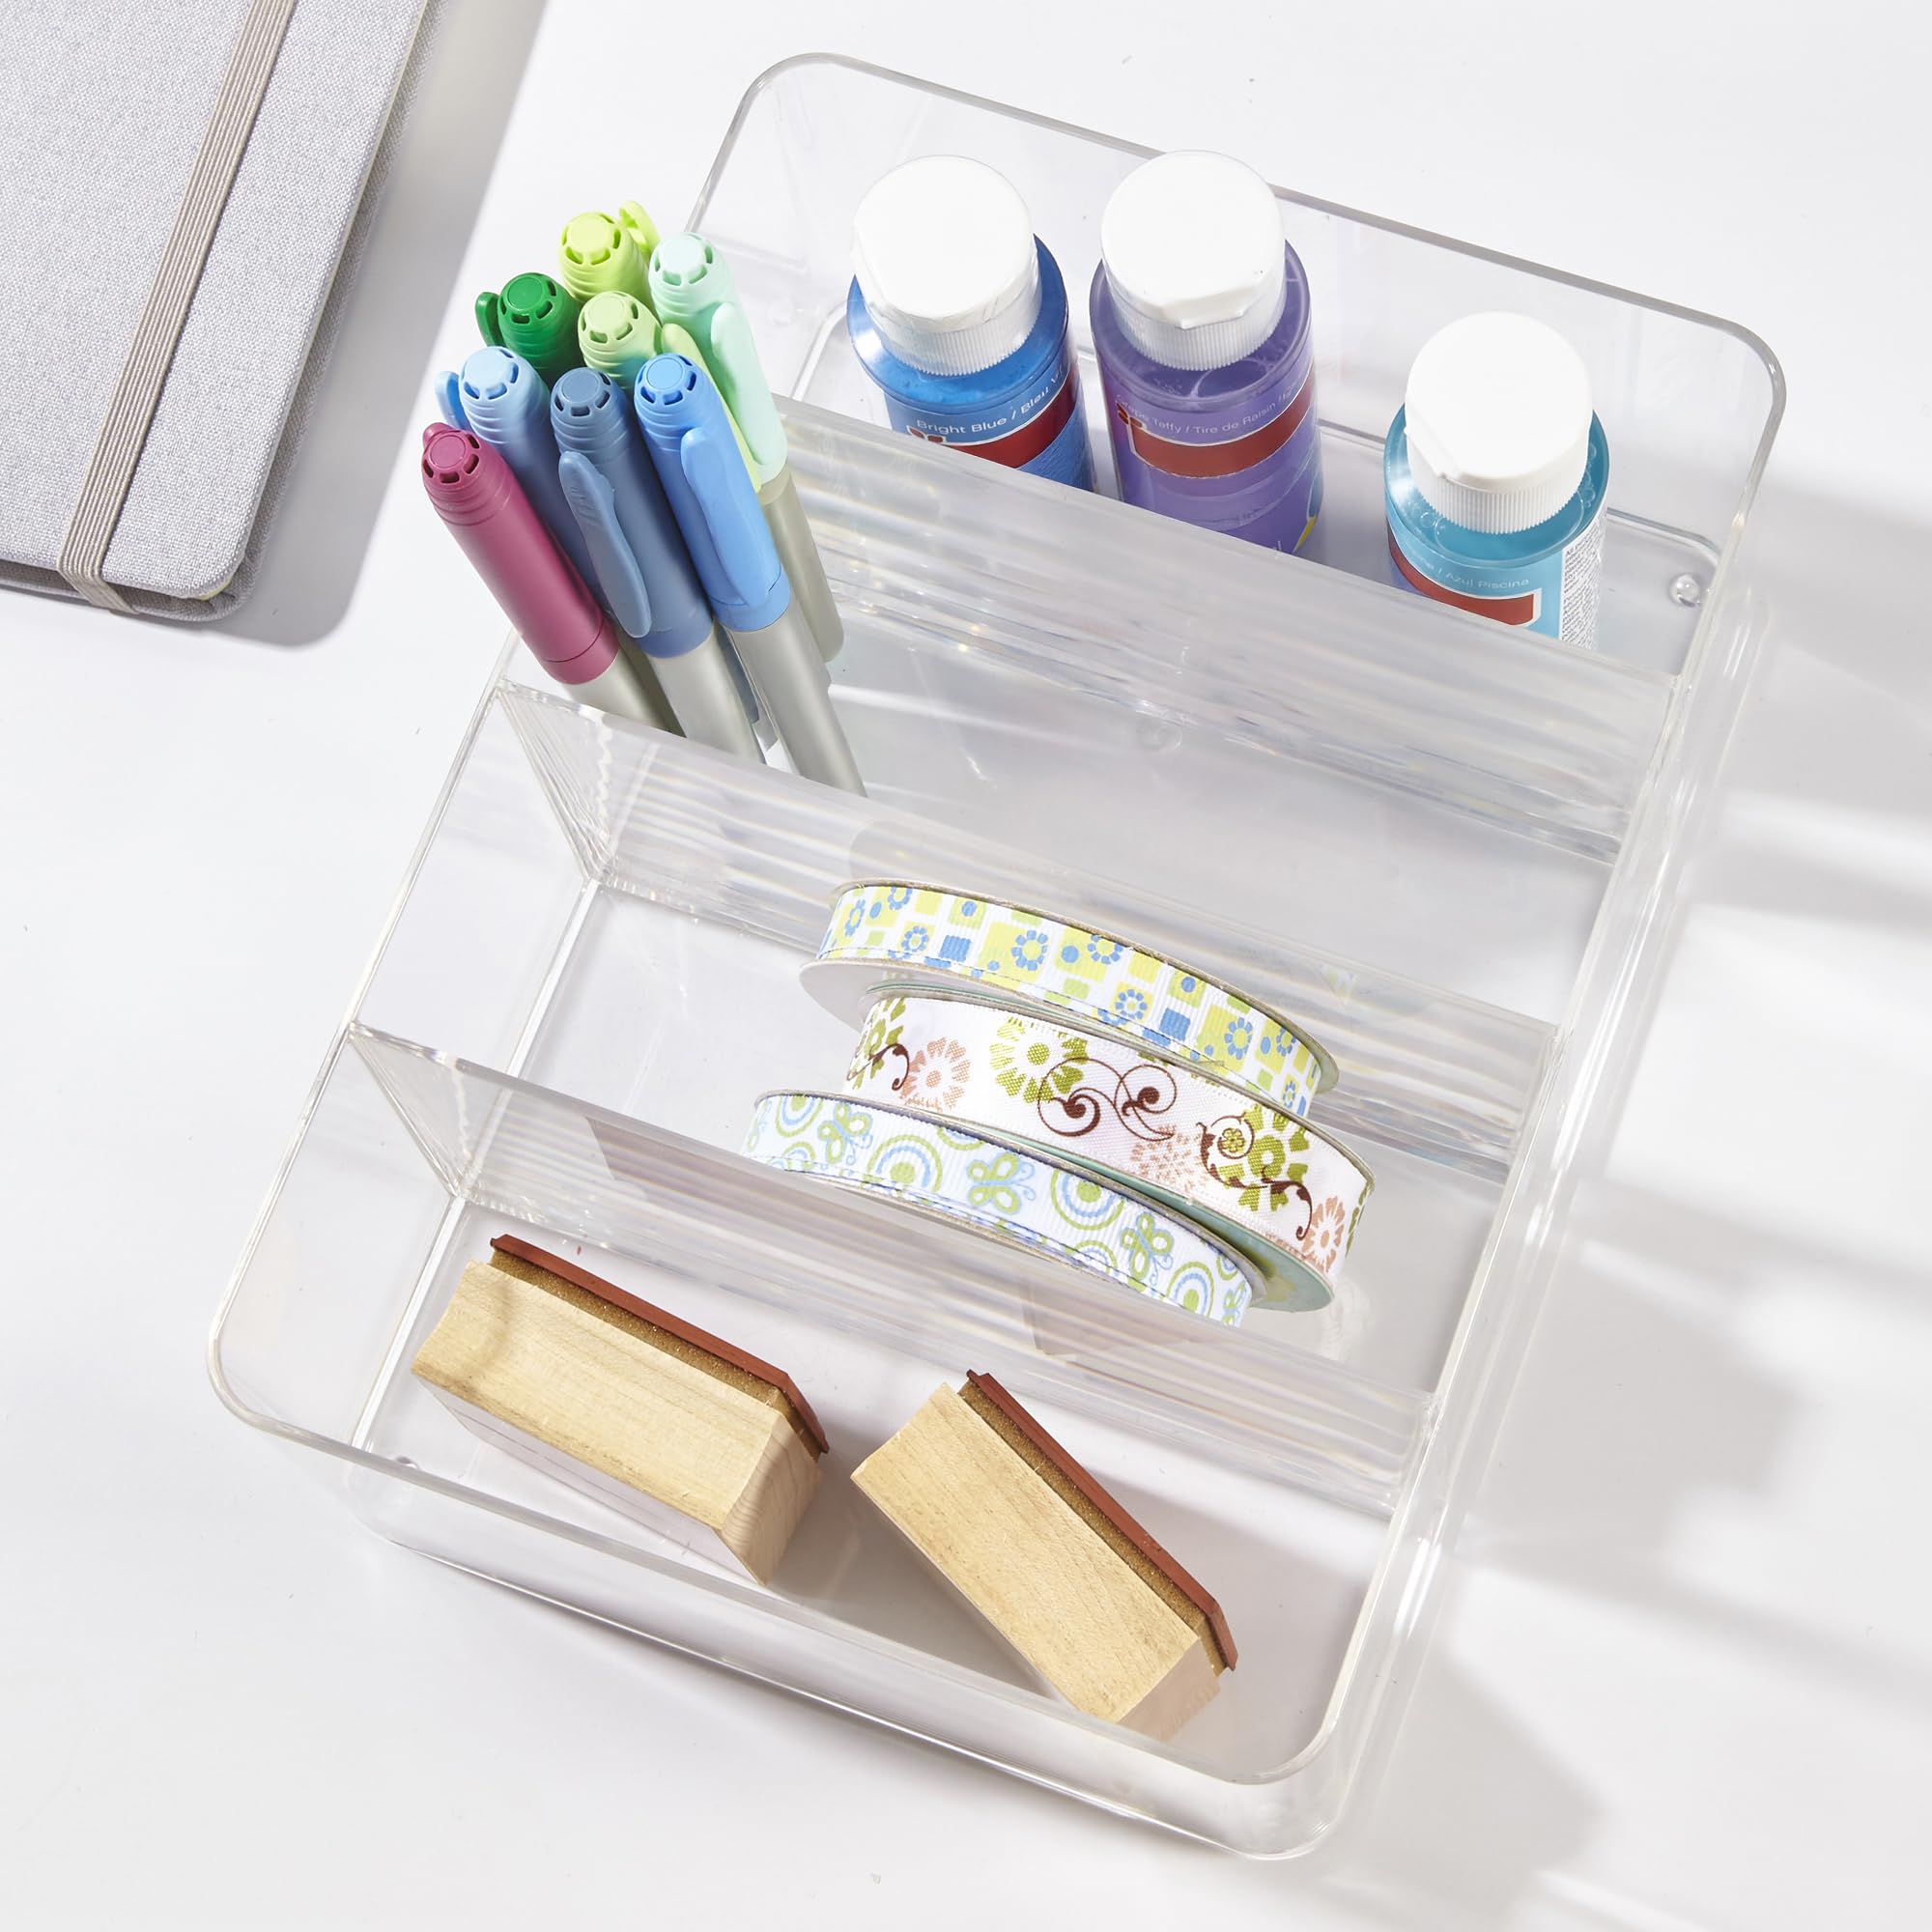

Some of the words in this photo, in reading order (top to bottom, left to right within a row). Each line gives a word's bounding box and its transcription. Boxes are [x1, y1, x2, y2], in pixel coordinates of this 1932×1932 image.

[917, 419, 966, 435] Bright
[971, 417, 1007, 433] Blue
[1221, 421, 1238, 432] de
[1242, 402, 1276, 425] Raisin
[1478, 579, 1530, 589] Piscina
